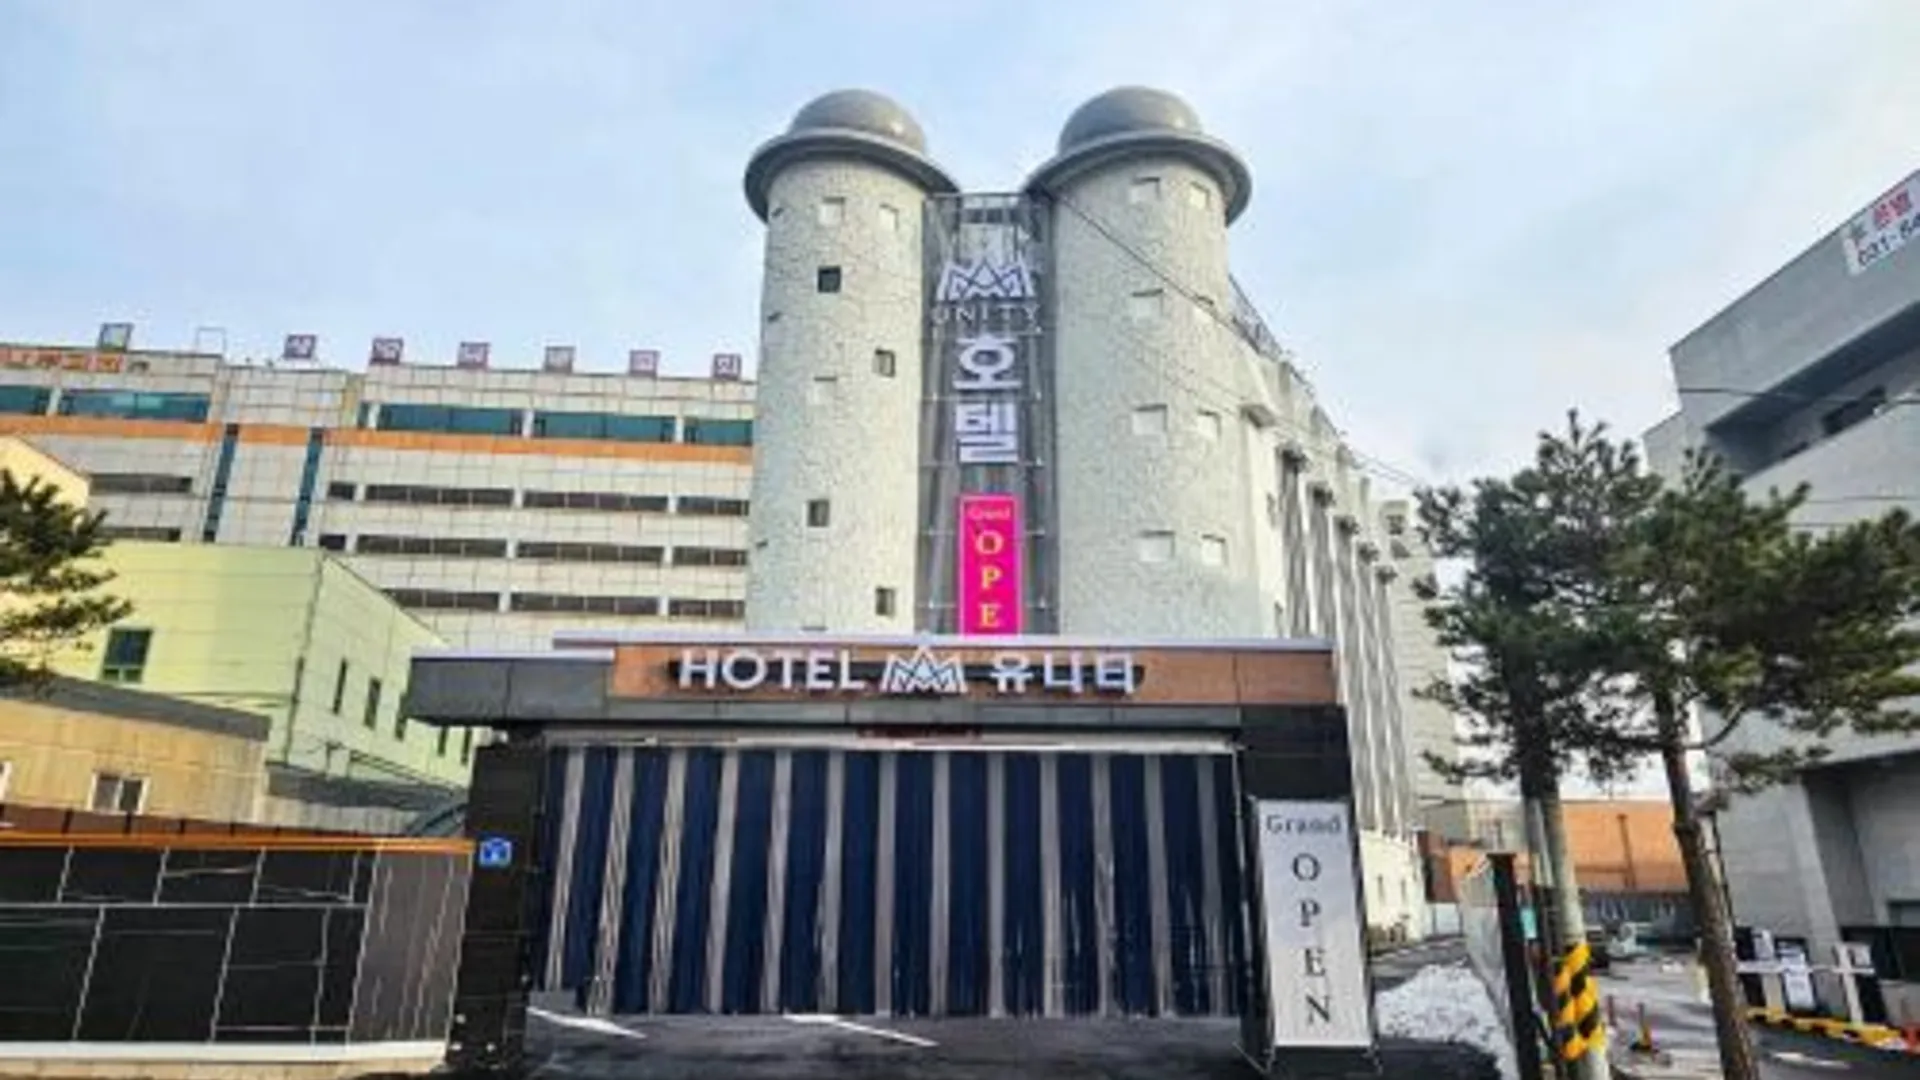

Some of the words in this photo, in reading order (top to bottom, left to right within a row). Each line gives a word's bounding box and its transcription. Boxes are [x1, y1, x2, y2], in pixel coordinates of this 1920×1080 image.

[931, 301, 1041, 326] UNITY
[953, 336, 1022, 464] 호텔
[678, 648, 865, 690] HOTEL
[990, 650, 1136, 693] 유니티
[1266, 813, 1342, 835] Grand
[1291, 852, 1332, 1025] OPEN
